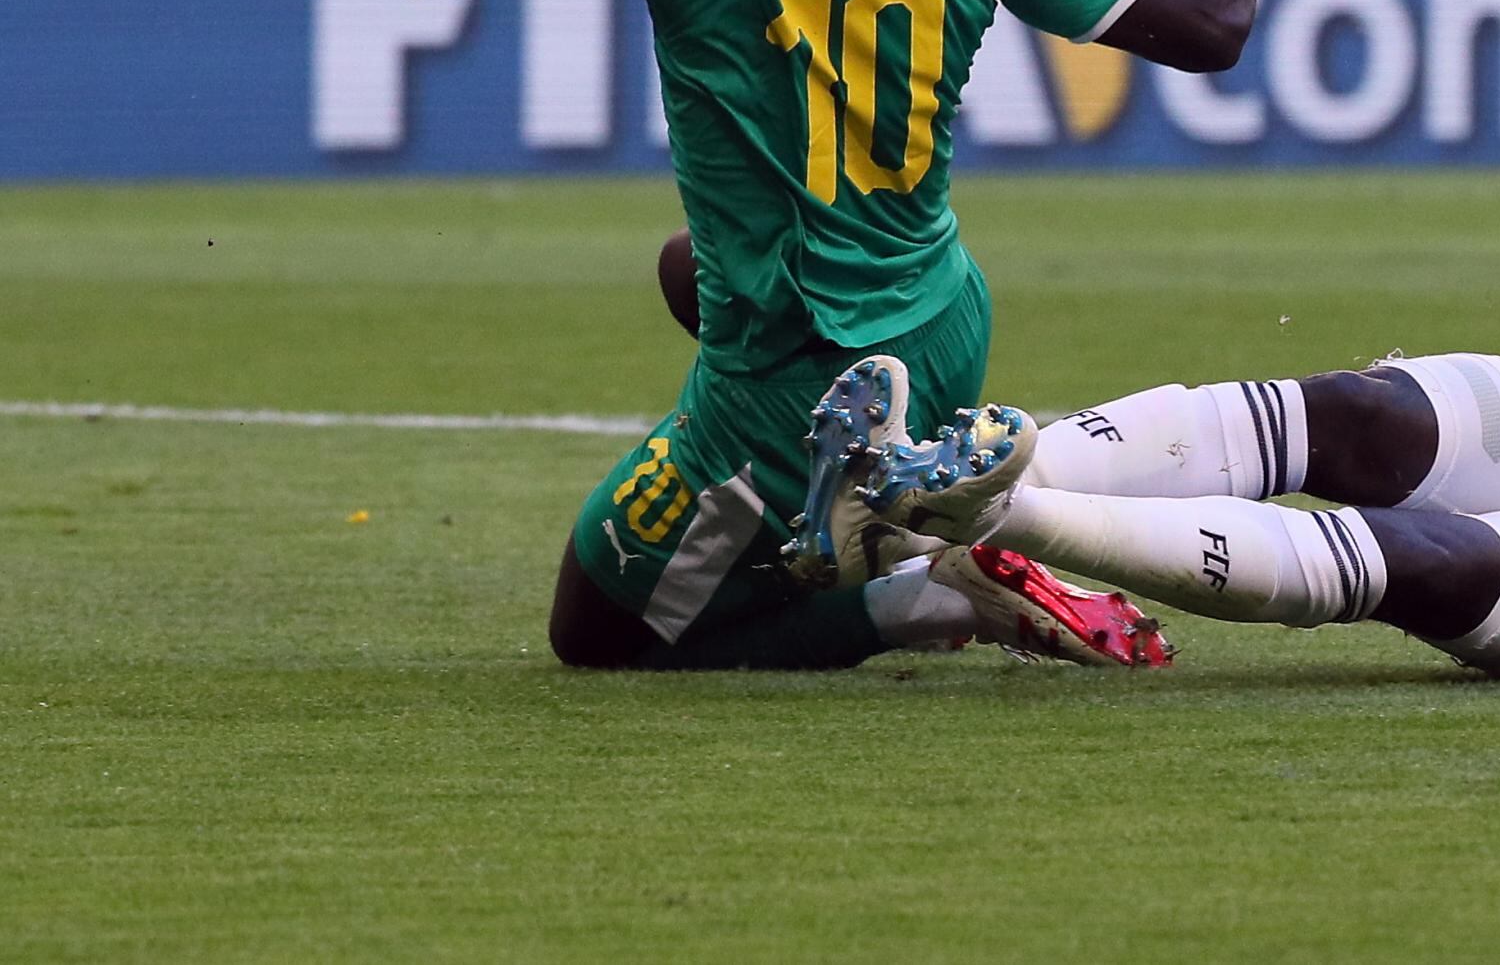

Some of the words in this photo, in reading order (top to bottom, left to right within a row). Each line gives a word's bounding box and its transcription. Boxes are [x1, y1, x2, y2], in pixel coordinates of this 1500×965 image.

[1062, 409, 1125, 443] FCF
[613, 436, 693, 544] 10
[1198, 527, 1231, 594] FCF
